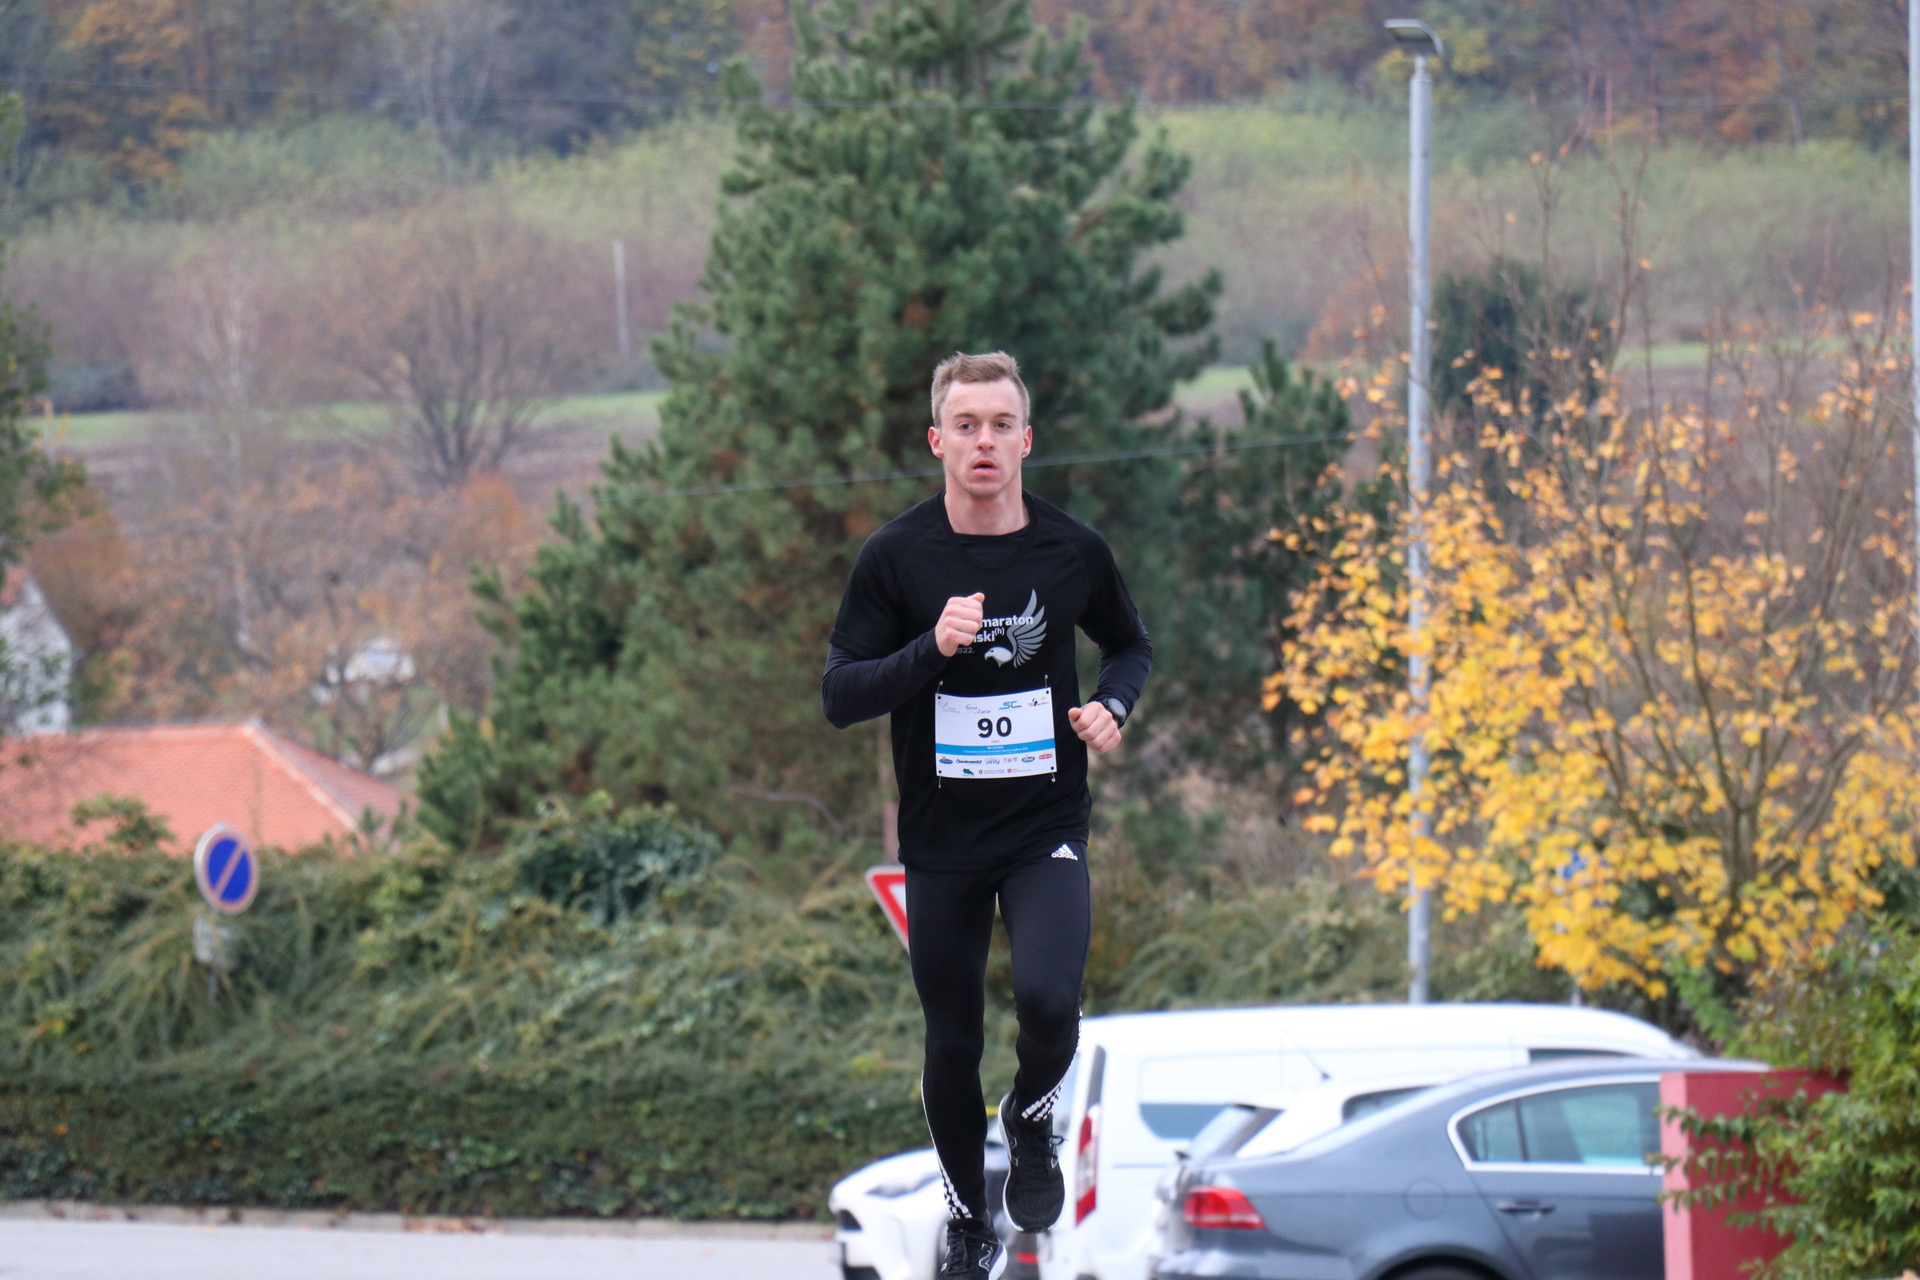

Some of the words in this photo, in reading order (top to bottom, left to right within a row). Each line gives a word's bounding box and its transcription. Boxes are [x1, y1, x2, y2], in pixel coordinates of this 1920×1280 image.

[956, 646, 975, 654] 022.
[977, 716, 1012, 739] 90
[1051, 850, 1078, 861] adidas
